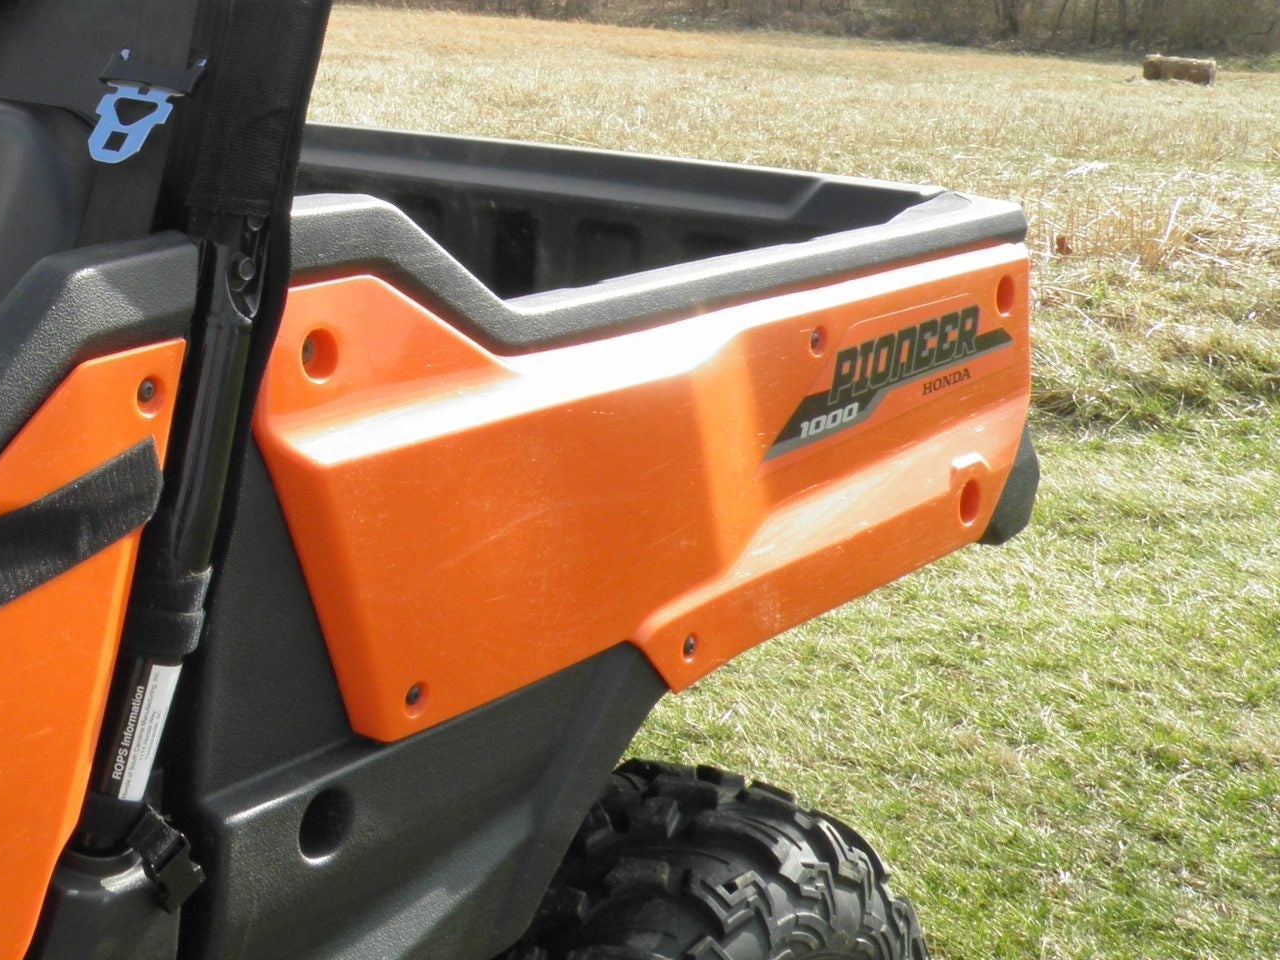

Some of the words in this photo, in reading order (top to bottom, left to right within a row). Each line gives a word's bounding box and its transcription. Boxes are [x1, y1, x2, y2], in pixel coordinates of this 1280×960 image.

[828, 304, 980, 405] PIONEER
[922, 368, 971, 396] HONDA
[800, 402, 859, 438] 1000
[112, 747, 128, 780] ROPS
[121, 685, 145, 746] Information
